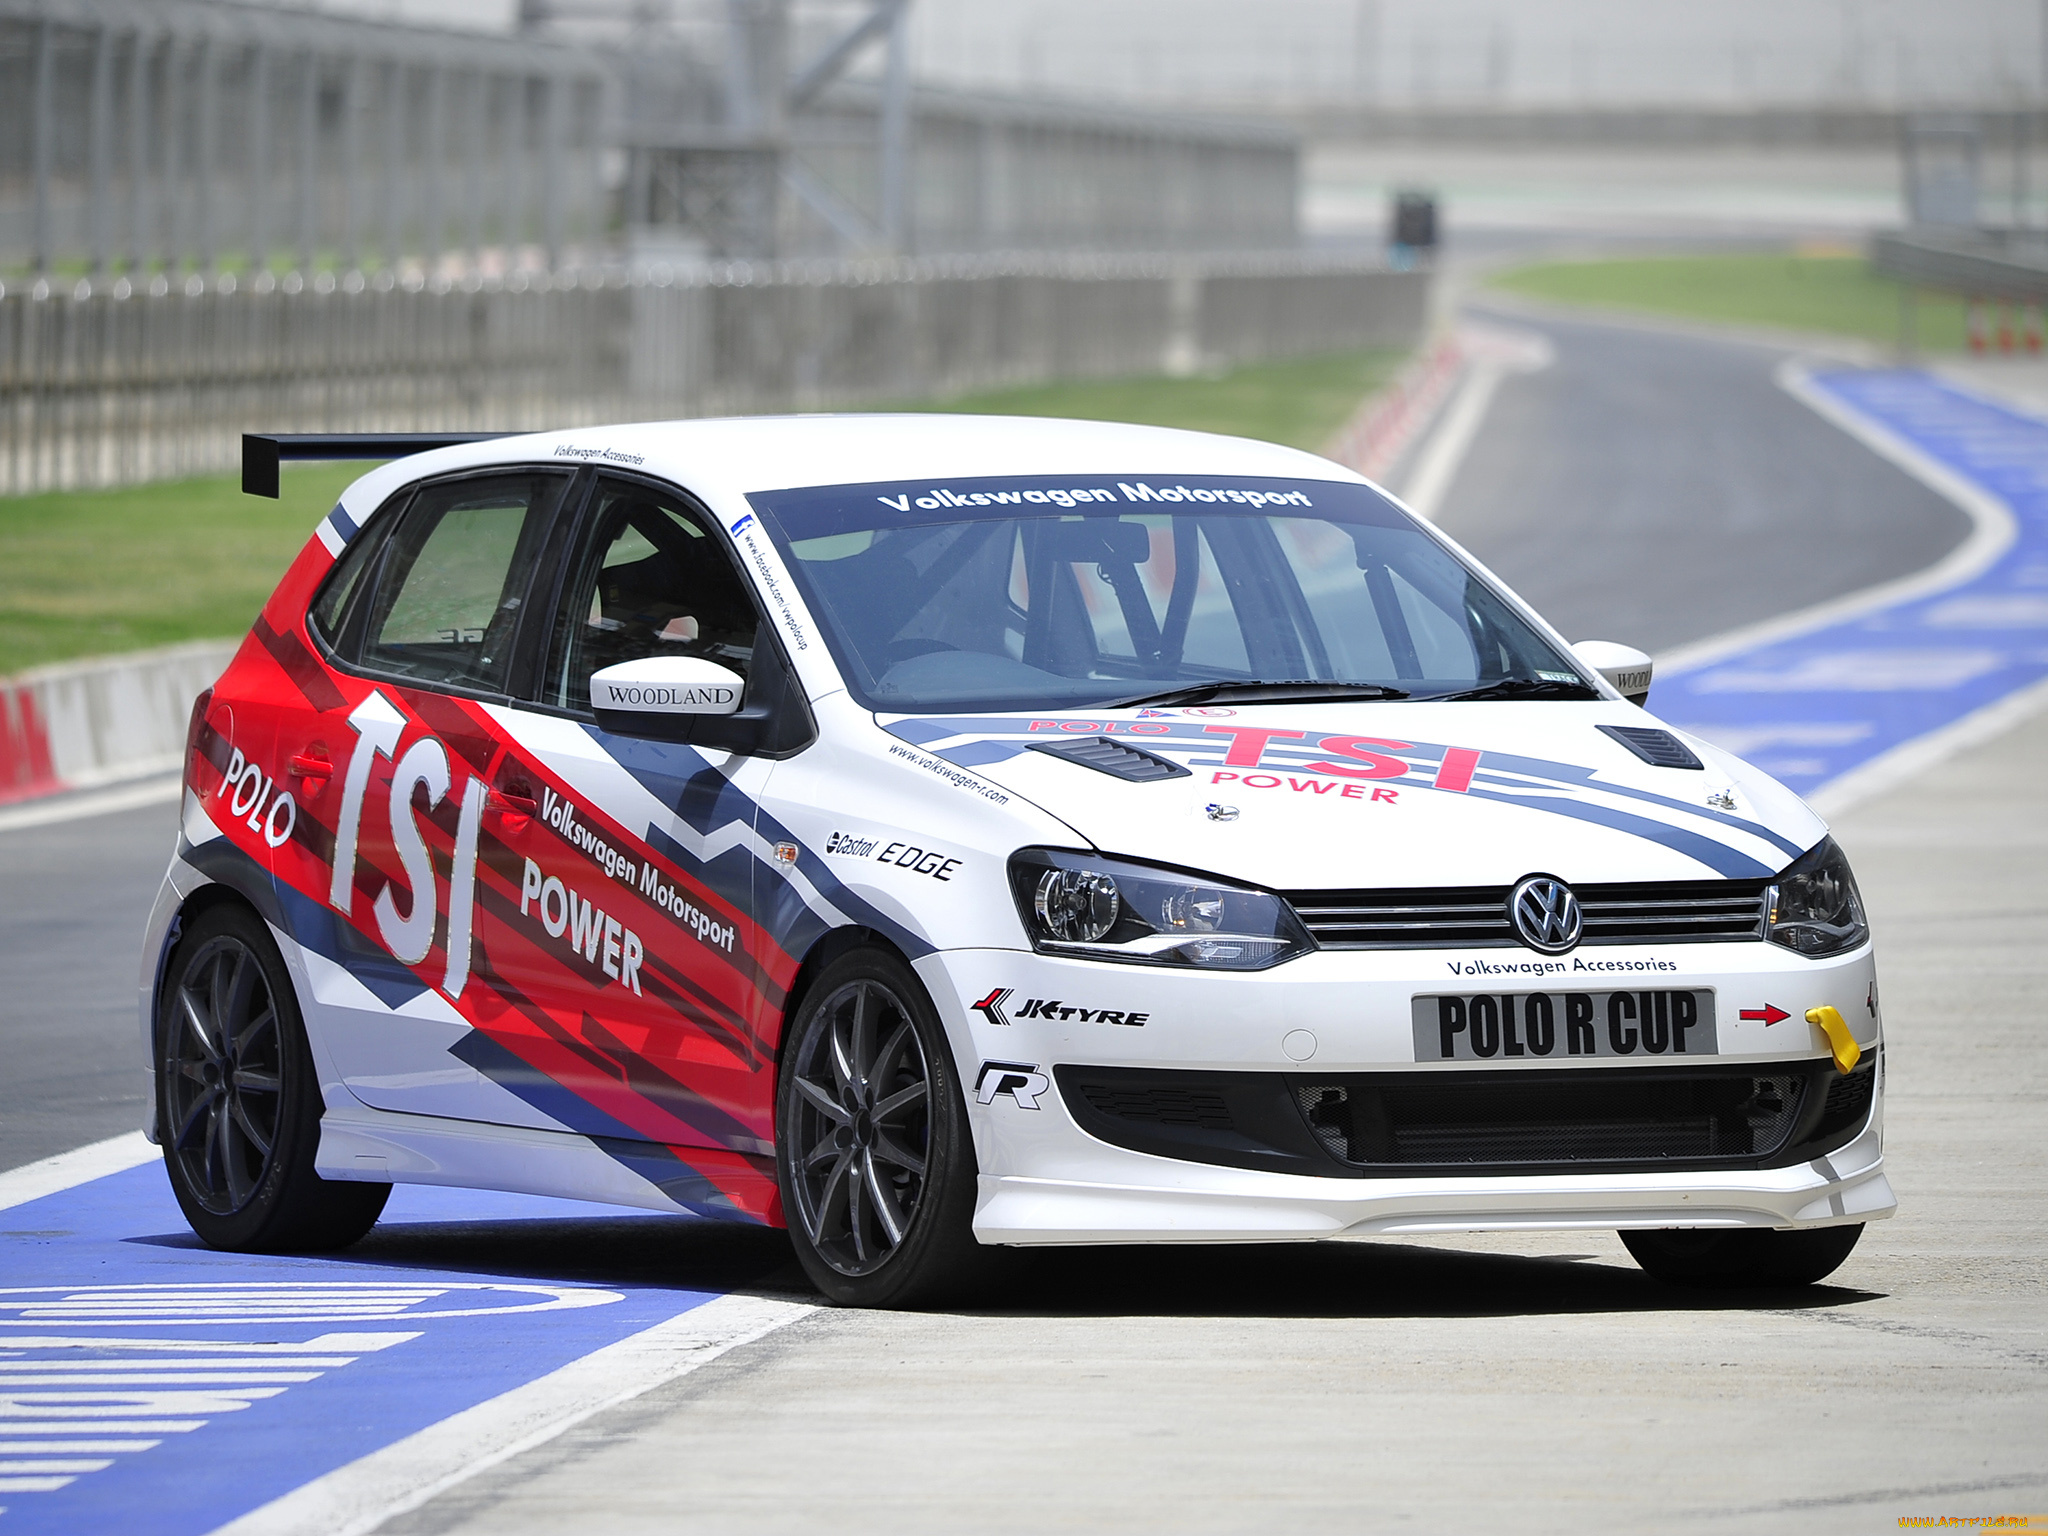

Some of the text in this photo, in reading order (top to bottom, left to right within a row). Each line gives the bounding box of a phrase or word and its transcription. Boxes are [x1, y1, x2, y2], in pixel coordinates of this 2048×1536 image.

[553, 445, 645, 465] Volkswagen Accessories
[878, 482, 1313, 511] Volkswagen Motorsport
[745, 534, 808, 651] www.facebook.com/vwpolocup
[608, 685, 734, 705] WOODLAND
[1027, 720, 1171, 734] POLO
[889, 744, 1010, 806] www.volkswagen-r.com
[1202, 724, 1483, 794] TSI
[216, 746, 297, 849] POLO
[1211, 771, 1400, 805] POWER
[329, 688, 490, 1002] TSI
[542, 786, 735, 953] Volkswagen Motorsport
[835, 834, 963, 881] Castrol EDGE
[520, 857, 645, 999] POWER
[1447, 957, 1677, 977] Volkswagen Accessories
[1438, 990, 1697, 1058] POLO R CUP
[972, 1059, 1049, 1110] R
